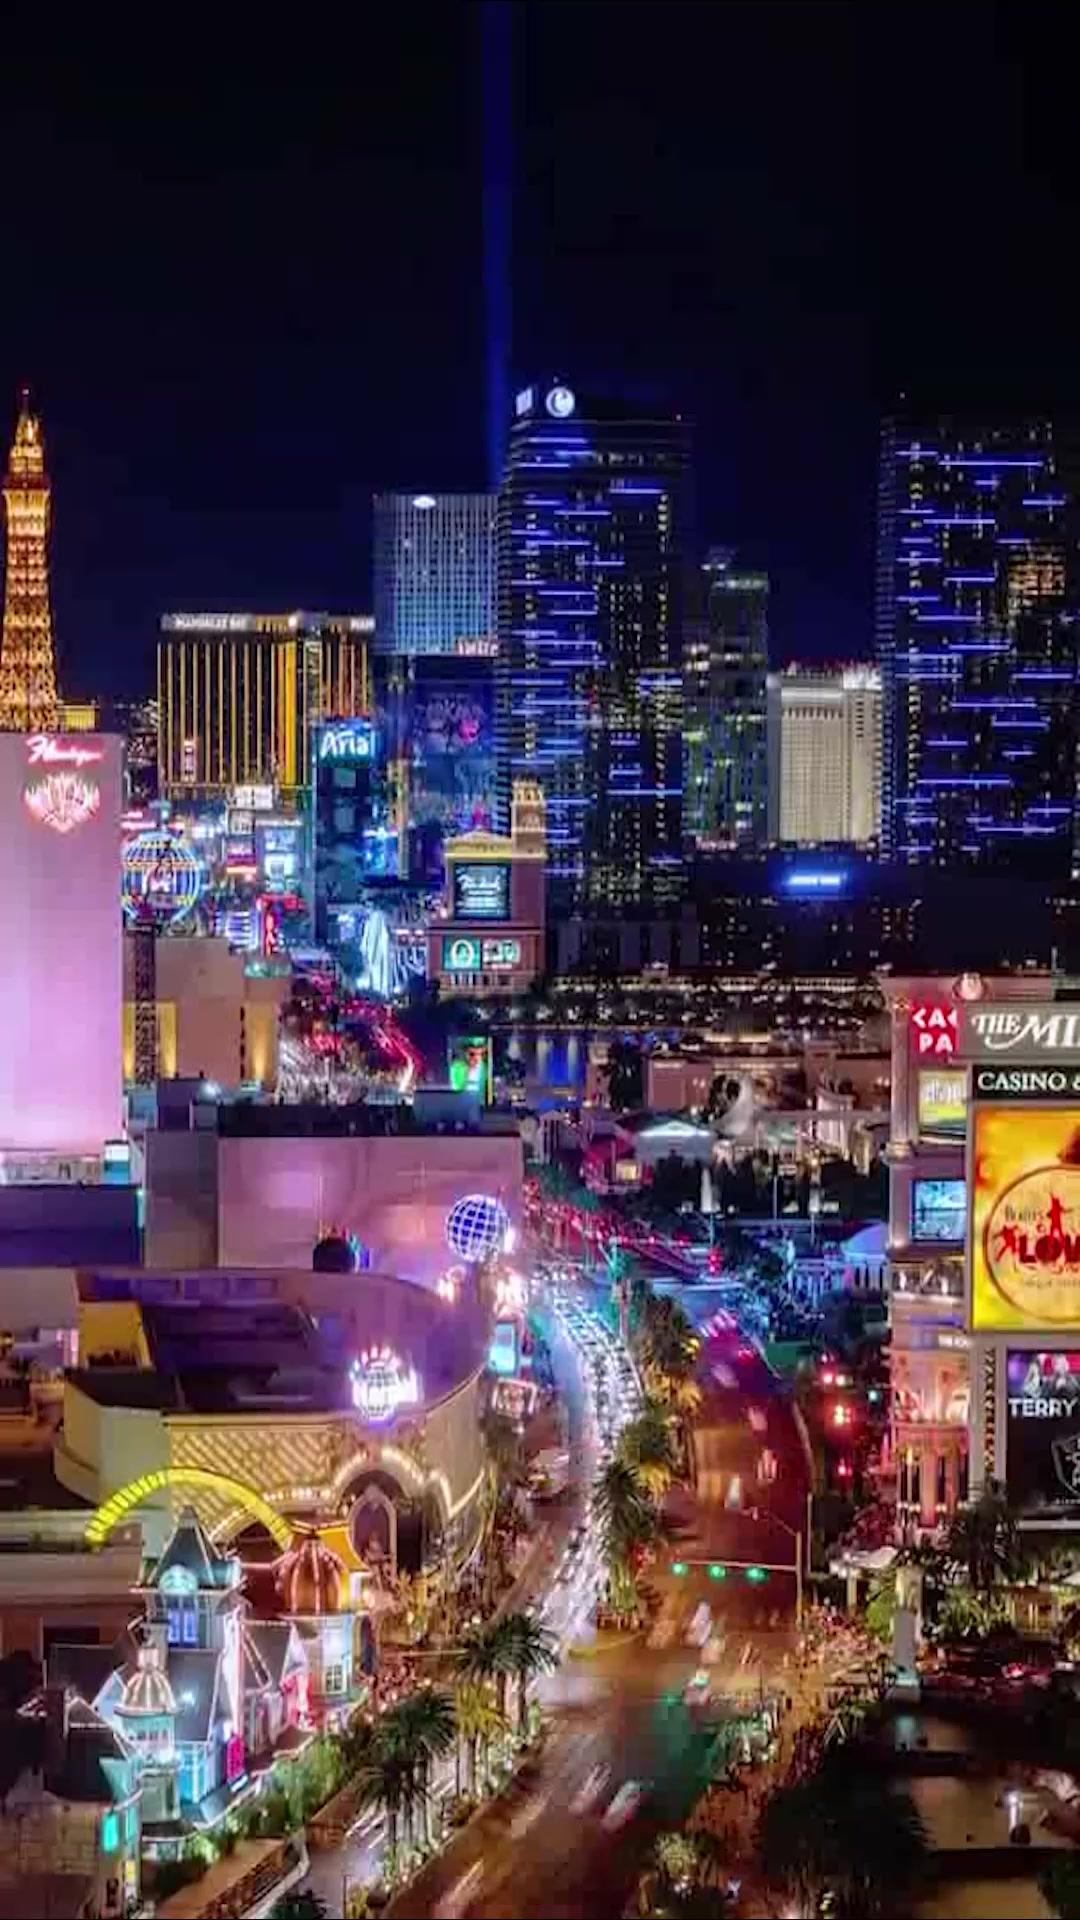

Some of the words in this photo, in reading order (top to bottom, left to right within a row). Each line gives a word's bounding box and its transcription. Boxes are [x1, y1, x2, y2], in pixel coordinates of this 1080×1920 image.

[320, 729, 369, 758] Aria
[971, 1013, 1021, 1034] THE
[984, 1013, 1080, 1050] MI
[977, 1071, 1068, 1092] CASINO
[1007, 1397, 1079, 1418] TERRY
